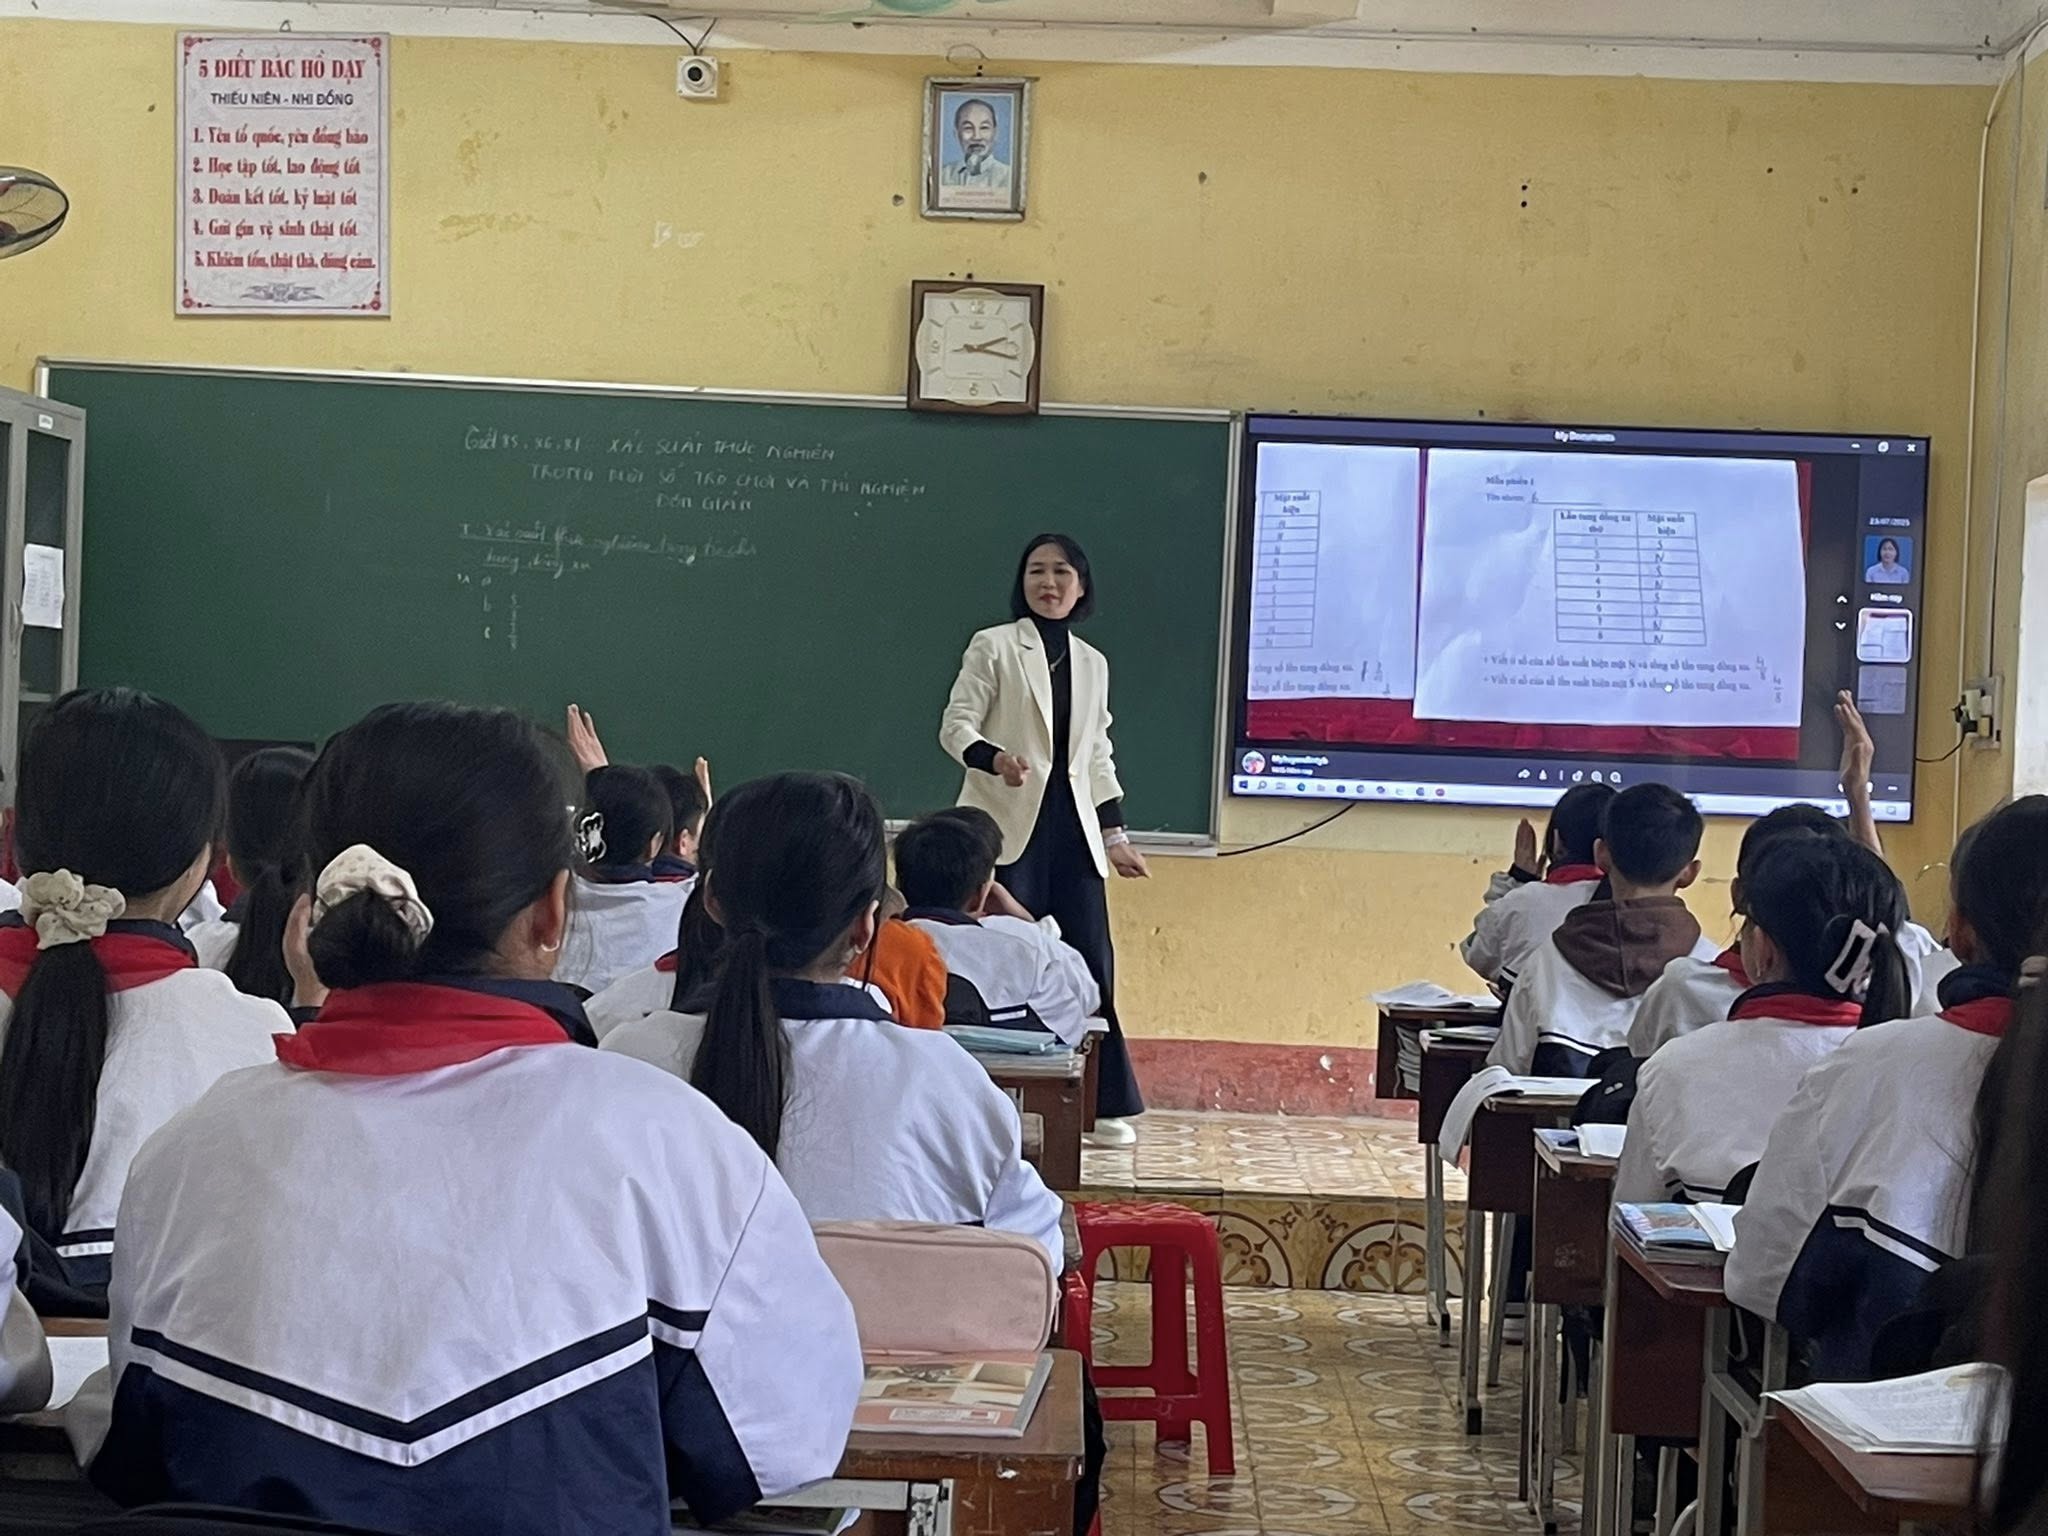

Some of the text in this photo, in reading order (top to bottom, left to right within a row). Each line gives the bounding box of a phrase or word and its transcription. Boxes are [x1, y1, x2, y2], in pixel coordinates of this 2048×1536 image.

[198, 60, 208, 78] 5
[261, 53, 295, 78] BÁC
[301, 49, 326, 78] HỒ
[332, 60, 366, 85] DẠY
[211, 88, 248, 105] THIẾU
[251, 91, 280, 105] NIÊN
[292, 93, 314, 105] NHI
[287, 158, 306, 174] lao
